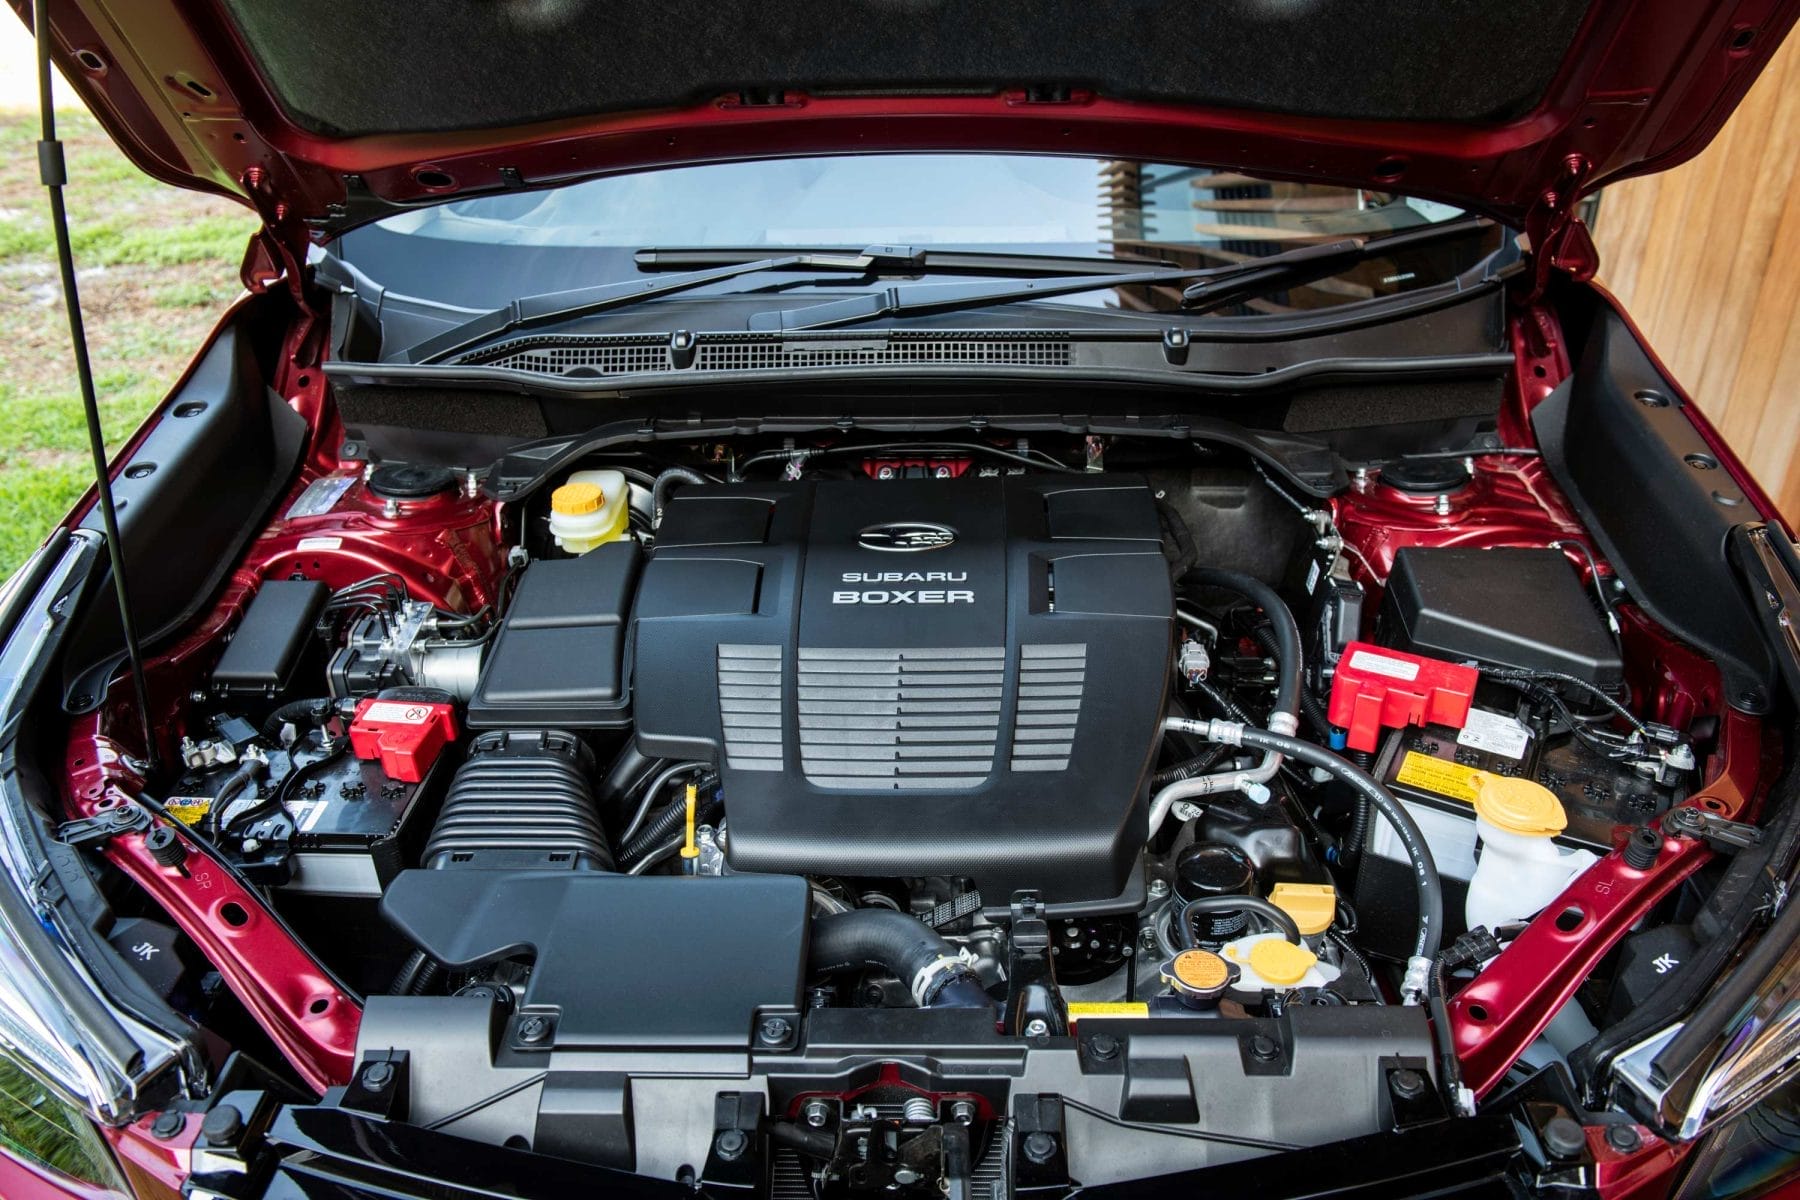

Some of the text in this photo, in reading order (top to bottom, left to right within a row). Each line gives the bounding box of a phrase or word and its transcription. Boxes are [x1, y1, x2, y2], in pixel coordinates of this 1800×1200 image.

[842, 571, 968, 583] SUBARU
[832, 590, 975, 604] BOXER
[195, 872, 212, 891] SR
[1595, 880, 1614, 895] SL
[132, 942, 160, 960] JK
[1652, 953, 1679, 973] JK
